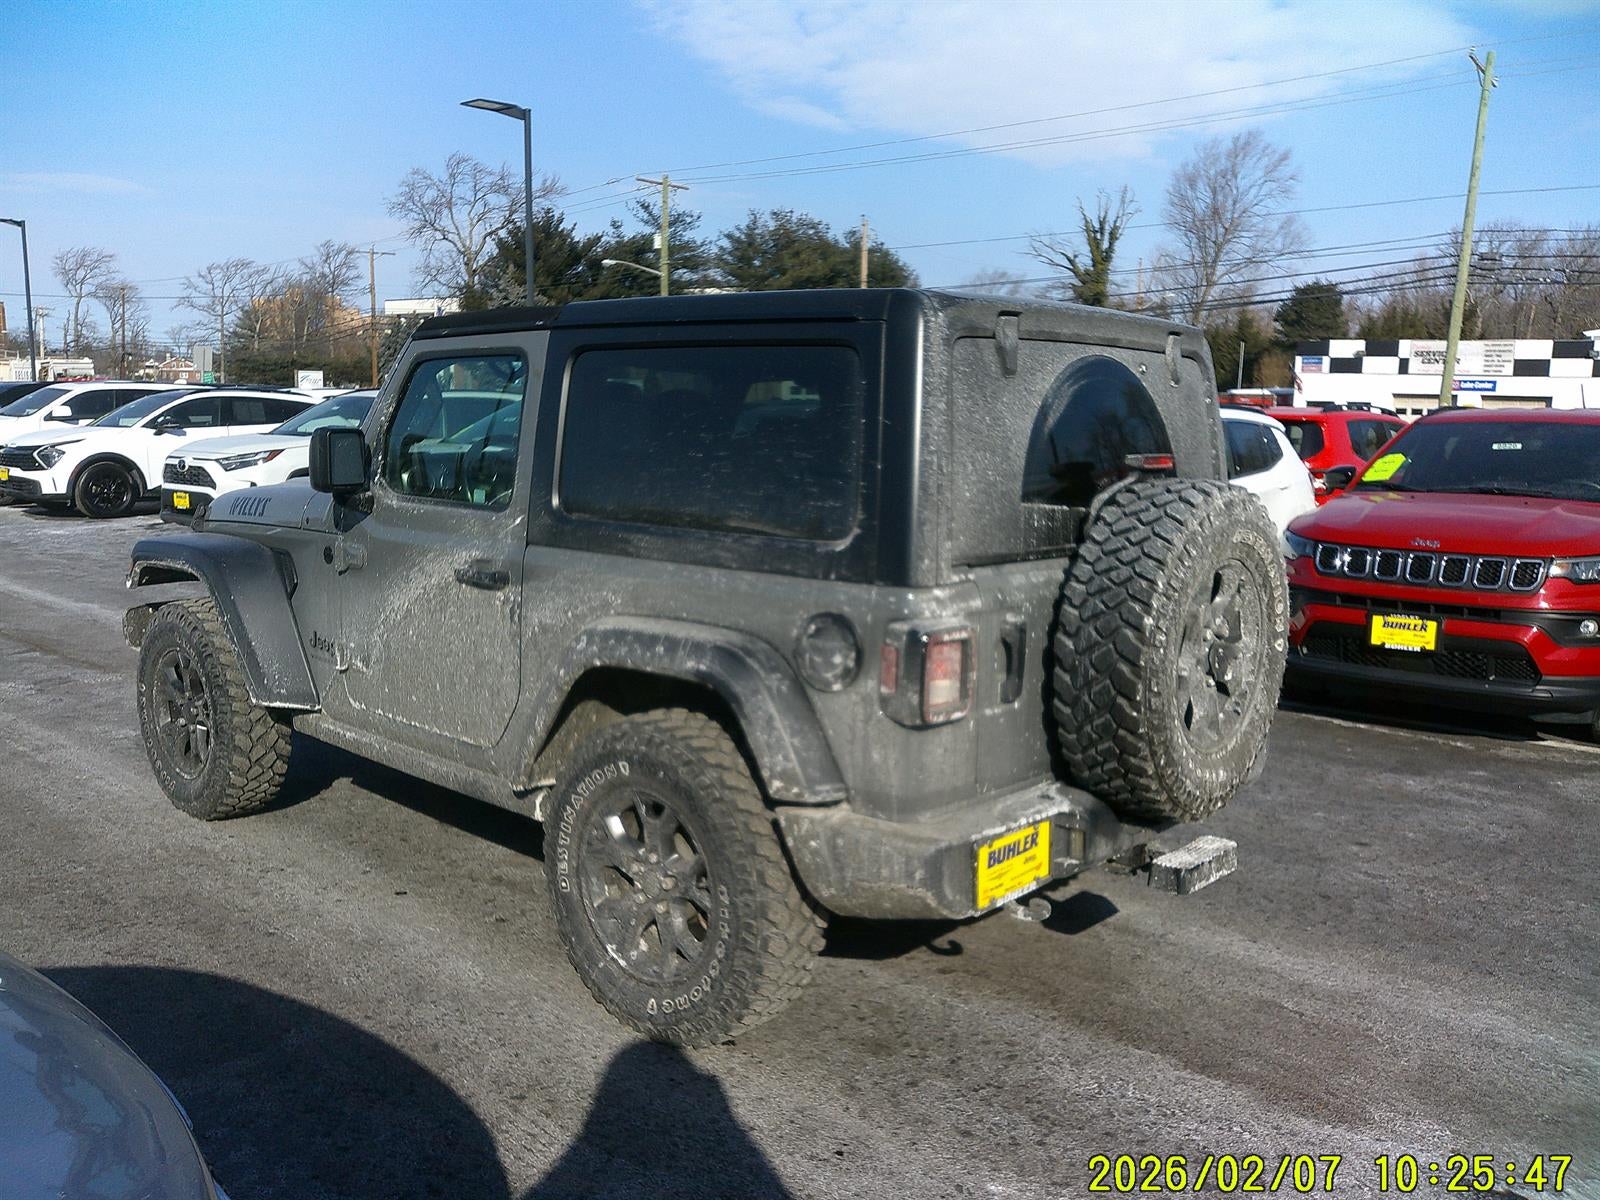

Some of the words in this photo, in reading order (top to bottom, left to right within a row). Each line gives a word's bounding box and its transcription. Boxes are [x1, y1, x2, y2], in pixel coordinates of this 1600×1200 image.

[1413, 350, 1448, 358] SERVIC
[229, 497, 272, 517] WILLYS
[1382, 621, 1428, 633] BUHLER
[557, 763, 617, 893] DESTINATION
[987, 832, 1039, 869] BUHLER
